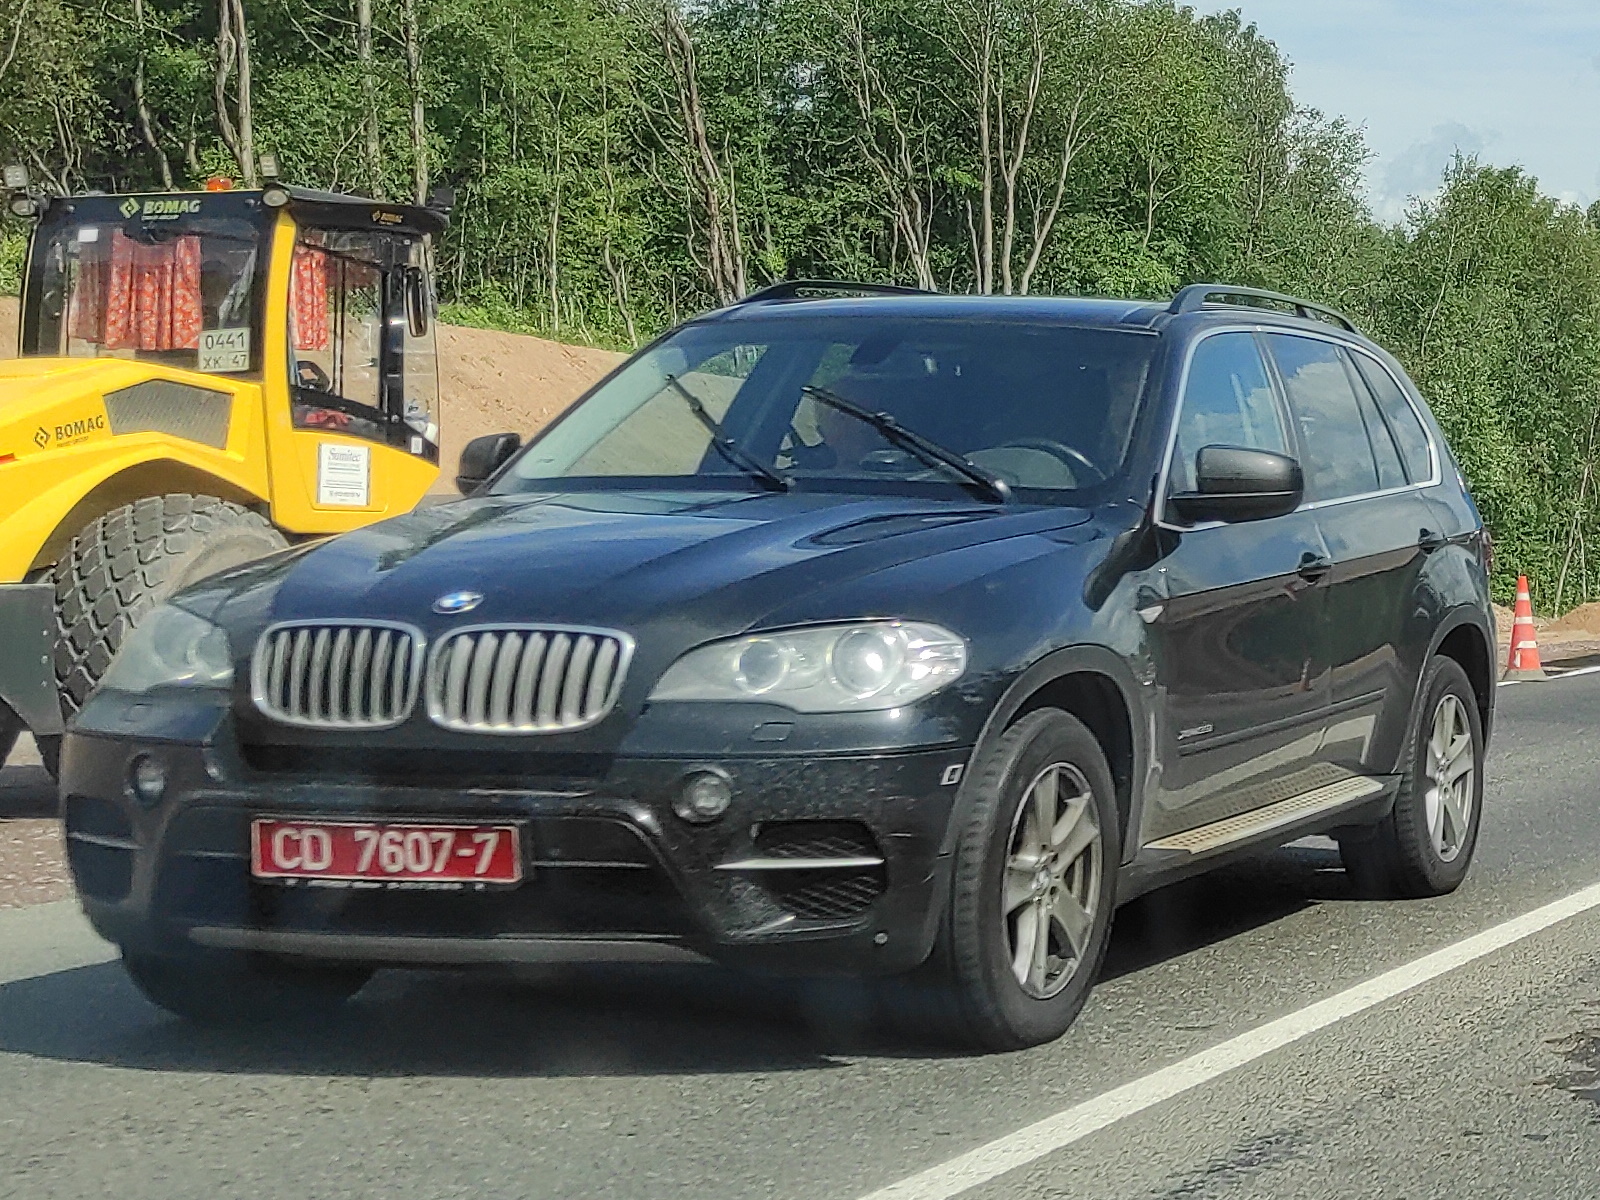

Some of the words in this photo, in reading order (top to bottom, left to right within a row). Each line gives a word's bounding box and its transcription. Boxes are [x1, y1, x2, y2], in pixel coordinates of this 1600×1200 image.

[143, 200, 201, 213] BOMAG
[206, 332, 244, 350] 0441
[232, 354, 247, 367] 47
[55, 414, 104, 441] BOMAG
[272, 828, 332, 871] CD
[353, 830, 500, 875] 7607-7
